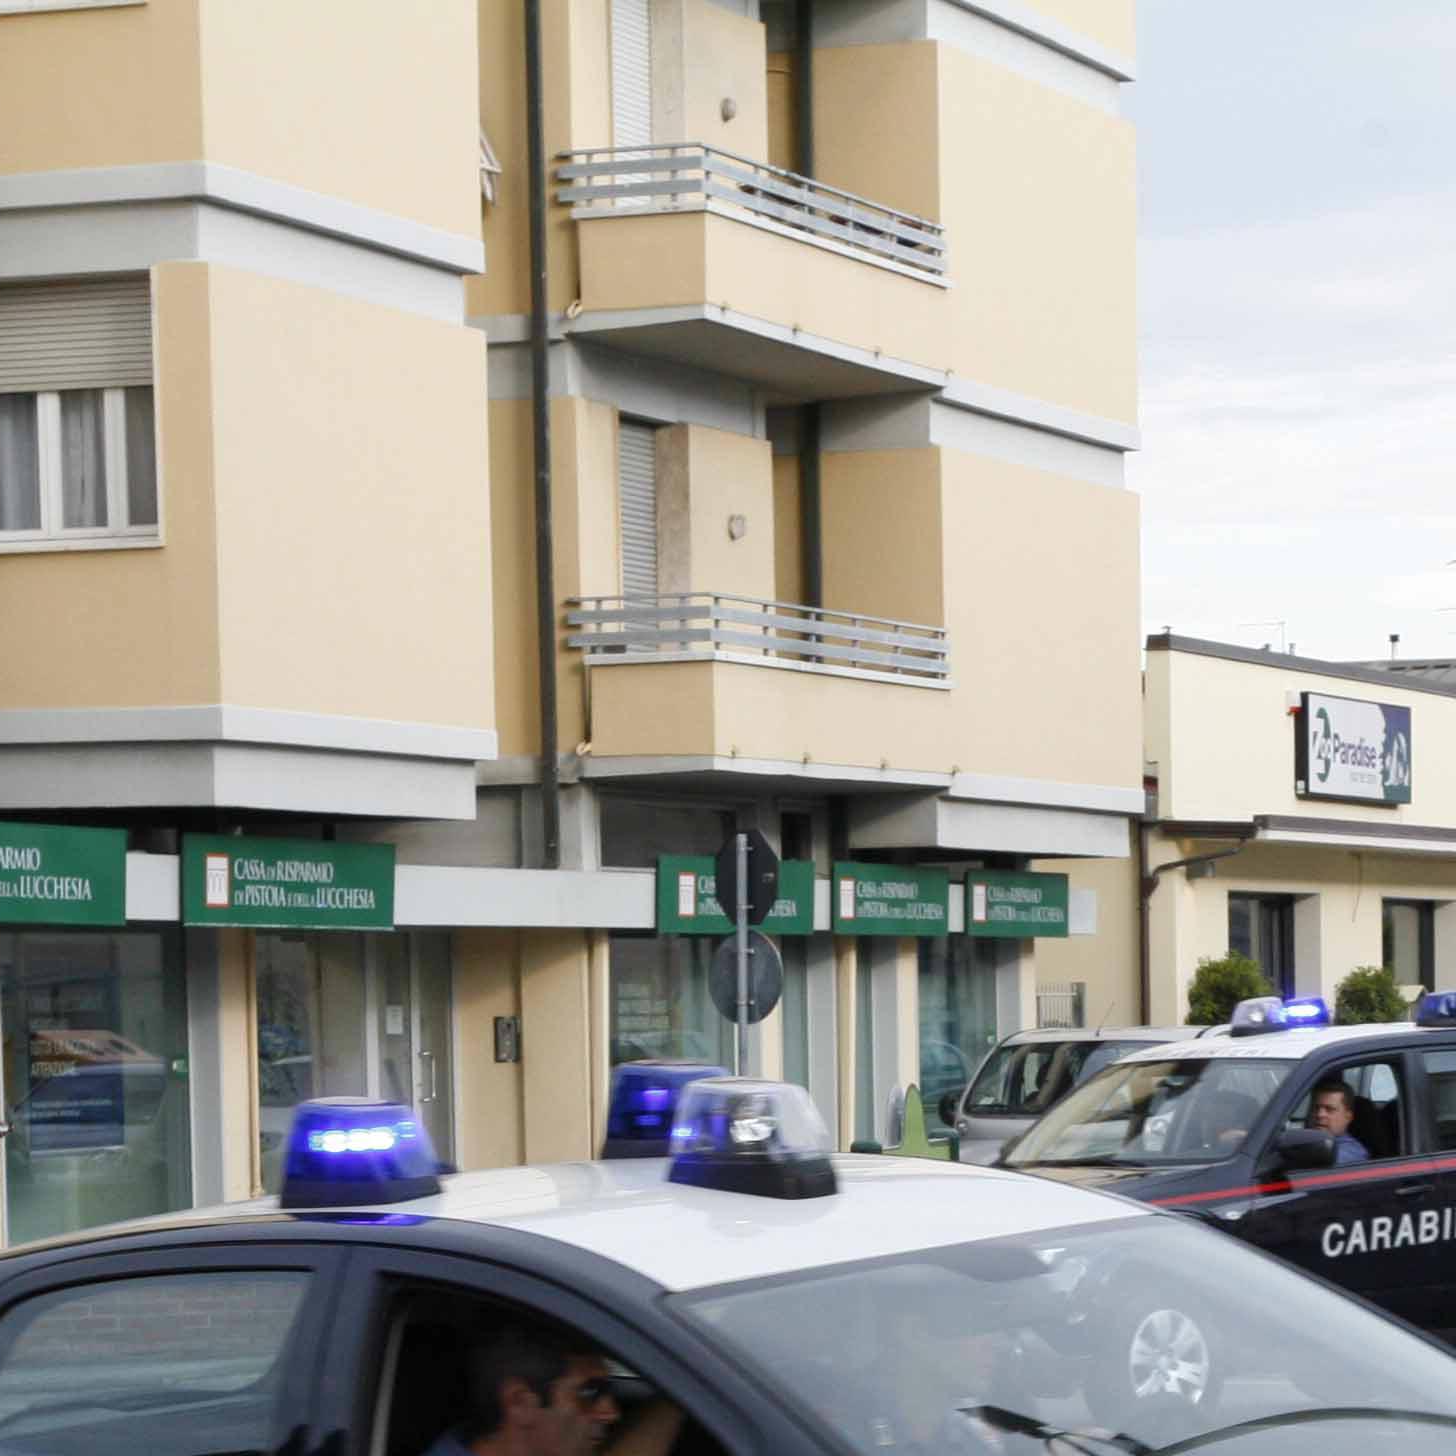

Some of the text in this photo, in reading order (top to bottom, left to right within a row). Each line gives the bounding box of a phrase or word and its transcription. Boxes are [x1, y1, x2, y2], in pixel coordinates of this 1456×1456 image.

[1333, 732, 1377, 769] Paradise
[234, 858, 267, 881] CASSA
[276, 860, 334, 883] RISPARMIO
[19, 875, 92, 901] LUCCHESIA
[245, 885, 286, 908] PISTOIA
[316, 888, 376, 910] LUCCHESIA
